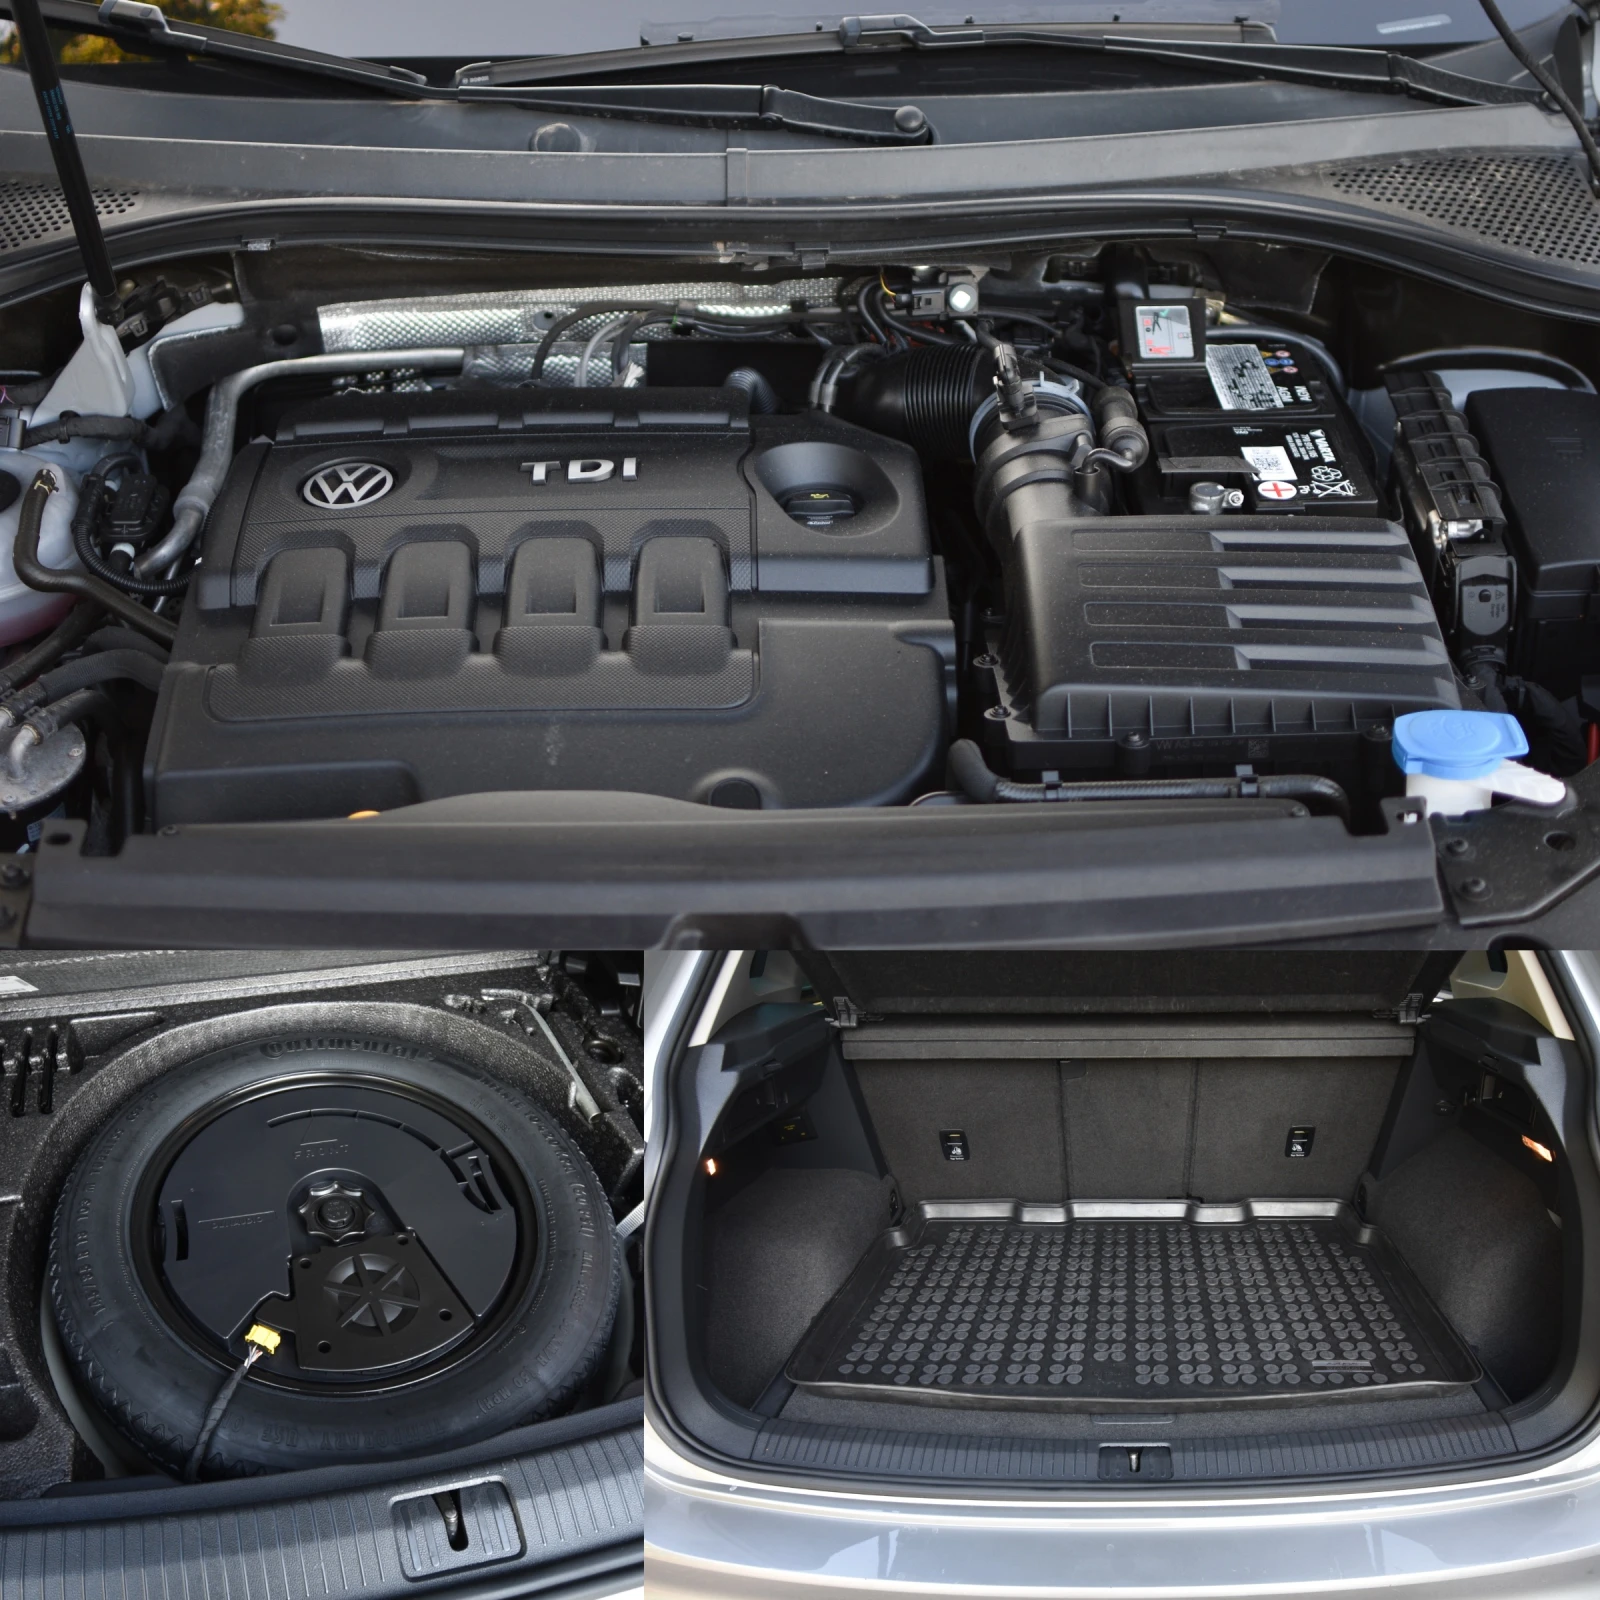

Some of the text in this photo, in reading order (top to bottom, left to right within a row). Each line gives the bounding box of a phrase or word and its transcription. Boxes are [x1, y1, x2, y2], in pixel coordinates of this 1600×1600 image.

[1275, 385, 1294, 402] AGM
[1315, 437, 1336, 462] VARTA
[520, 457, 638, 485] TDI
[1298, 485, 1310, 494] Pb
[259, 1036, 421, 1062] Continental
[477, 1385, 512, 1415] MPH)
[260, 1423, 300, 1447] USE
[319, 1417, 446, 1450] TEMPORARY
